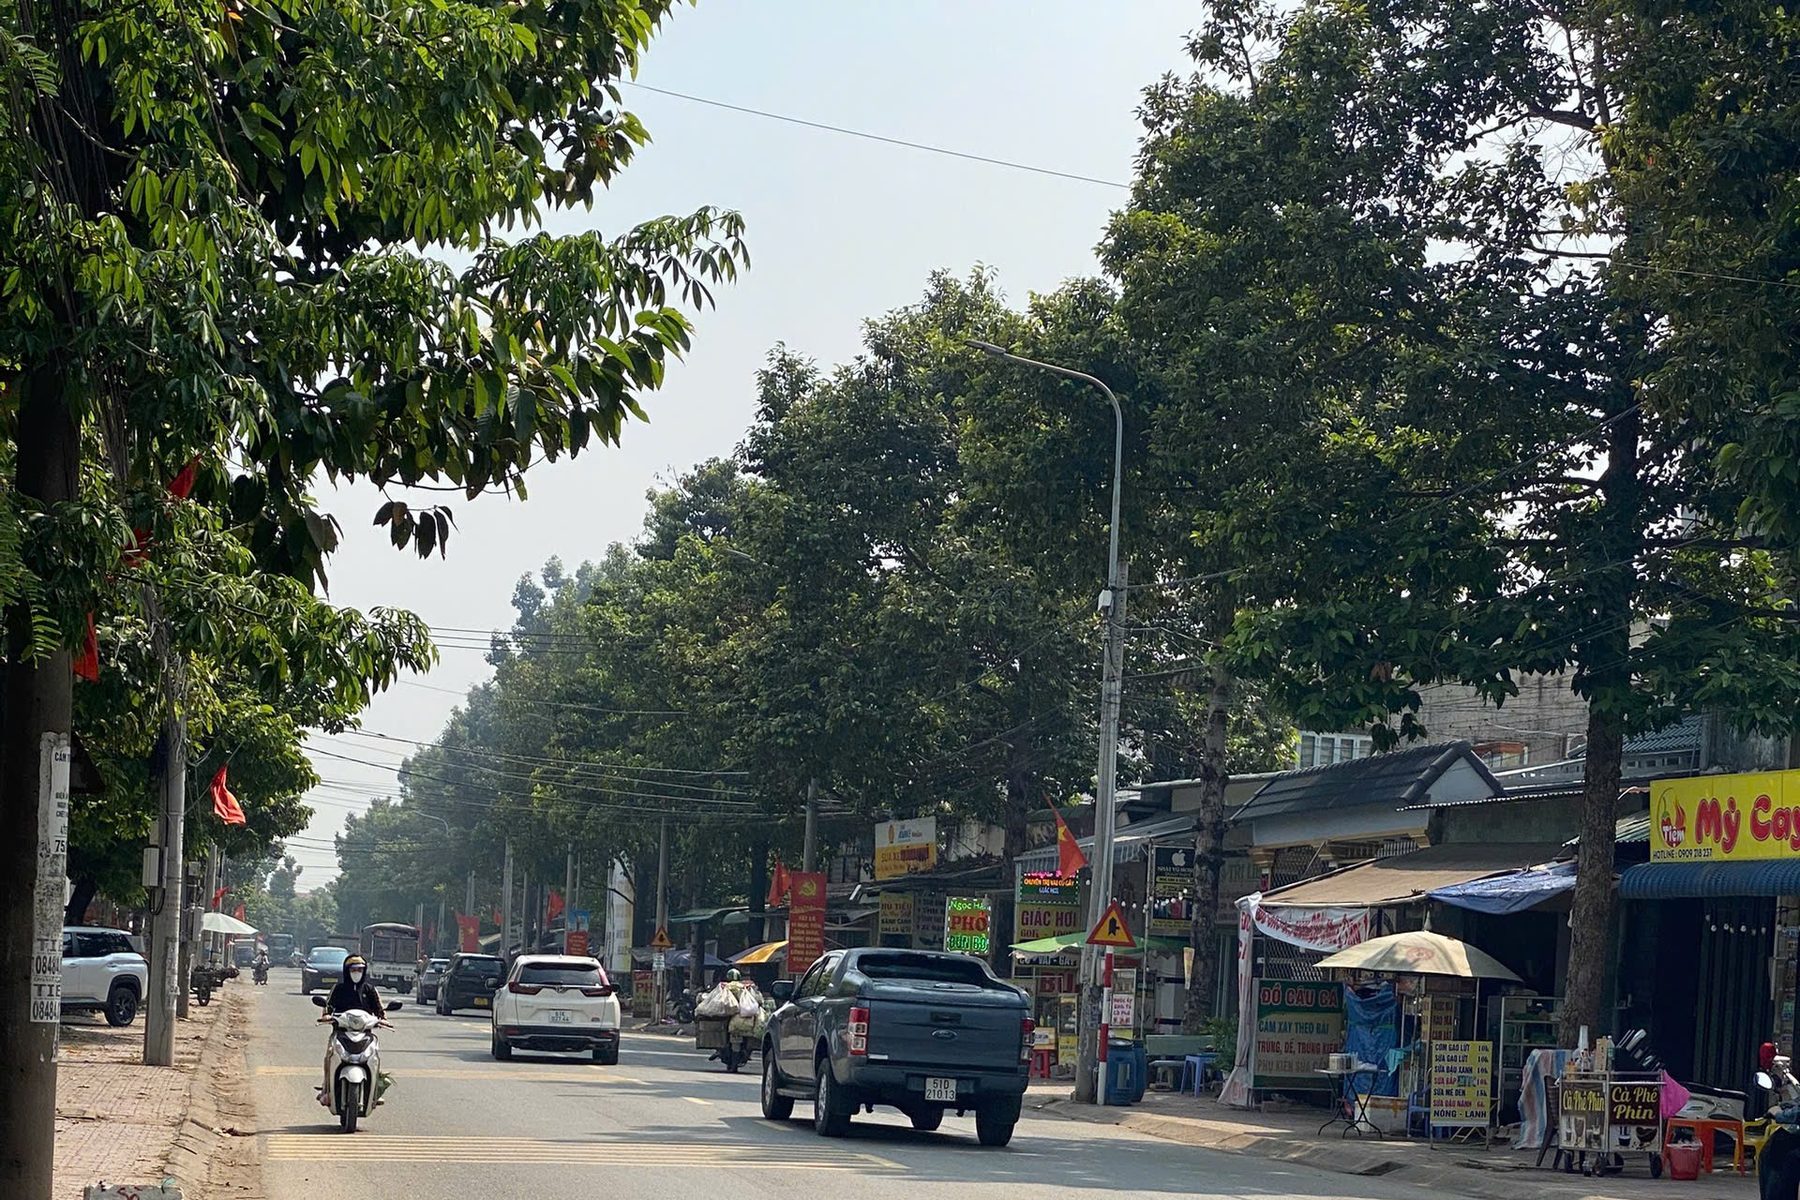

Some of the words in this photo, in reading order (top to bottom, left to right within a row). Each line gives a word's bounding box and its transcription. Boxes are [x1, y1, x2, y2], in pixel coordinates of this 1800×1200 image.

[951, 911, 988, 931] PHỞ
[1021, 907, 1051, 927] GIÁC
[1261, 983, 1281, 1005] ĐỒ
[933, 1079, 949, 1089] 51D
[1612, 1086, 1631, 1103] Cà
[1633, 1086, 1658, 1103] Phê
[1434, 1109, 1456, 1118] NÓNG
[1465, 1110, 1486, 1120] LẠNH
[1613, 1105, 1655, 1120] Phin
